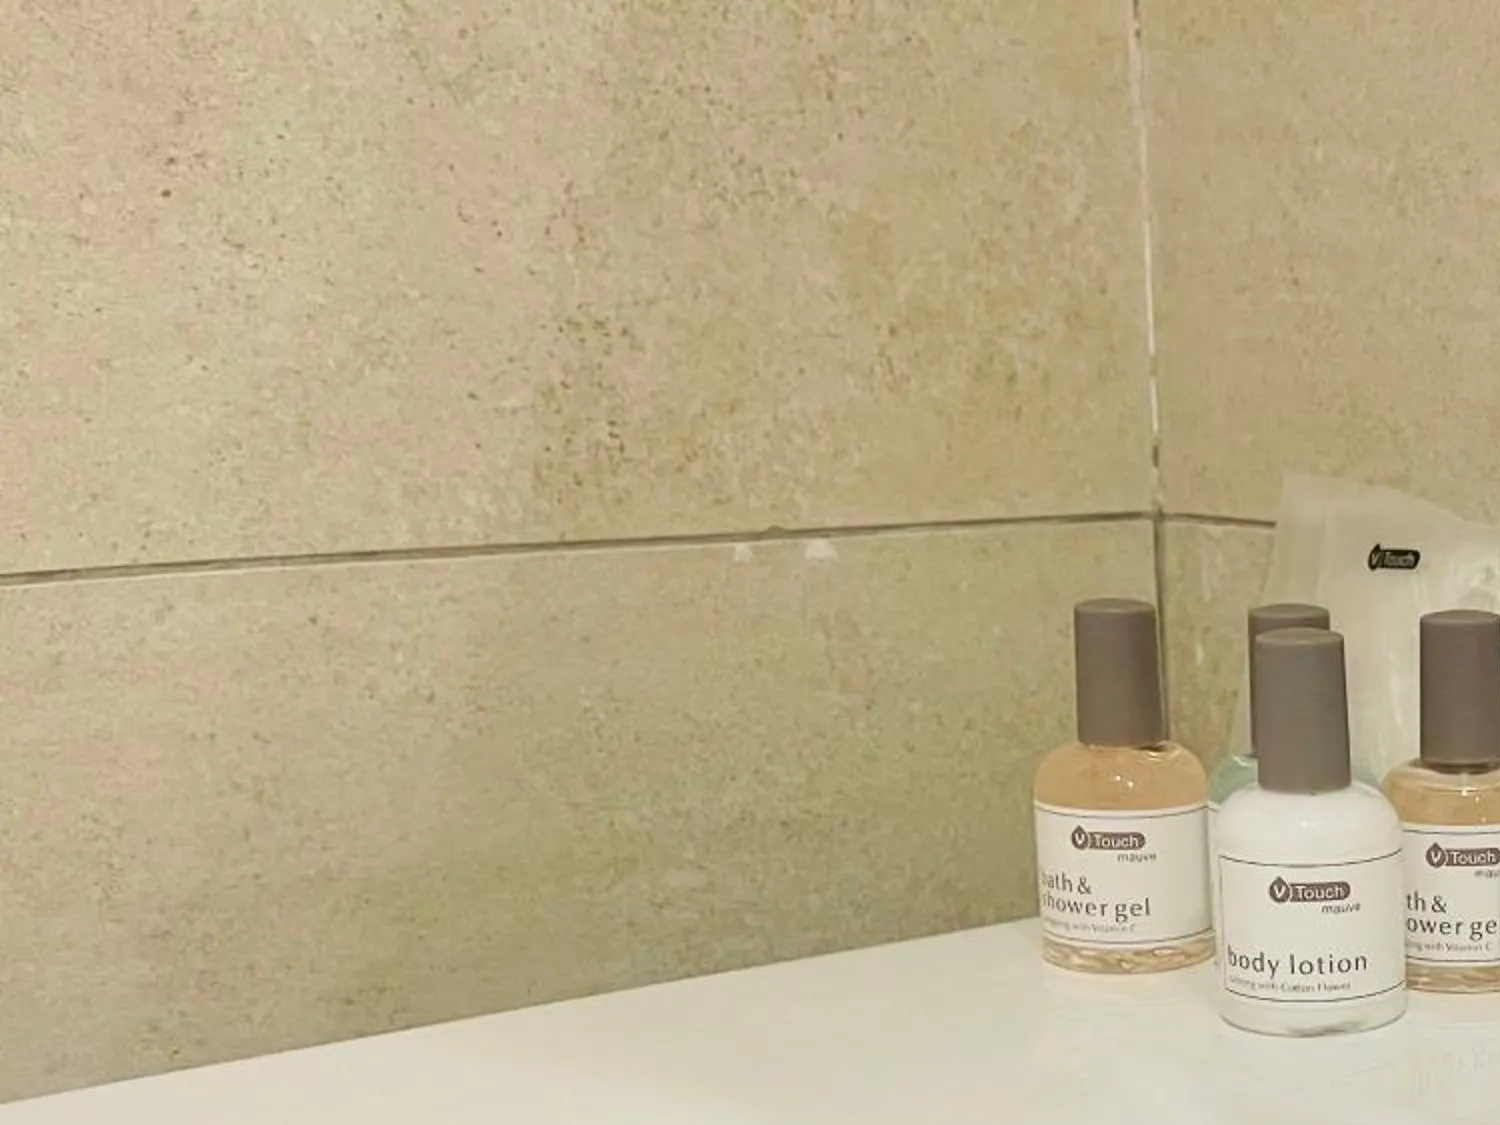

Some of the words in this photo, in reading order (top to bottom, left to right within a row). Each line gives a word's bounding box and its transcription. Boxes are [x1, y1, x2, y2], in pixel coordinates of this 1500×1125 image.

[1093, 834, 1140, 849] Touch
[1451, 851, 1497, 865] Touch
[1077, 876, 1093, 895] &
[1295, 885, 1346, 900] Touch
[1114, 896, 1152, 924] gel
[1406, 890, 1427, 912] th
[1431, 895, 1447, 914] &
[1406, 916, 1464, 936] ower
[1227, 943, 1280, 979] body
[1289, 952, 1368, 976] lotion
